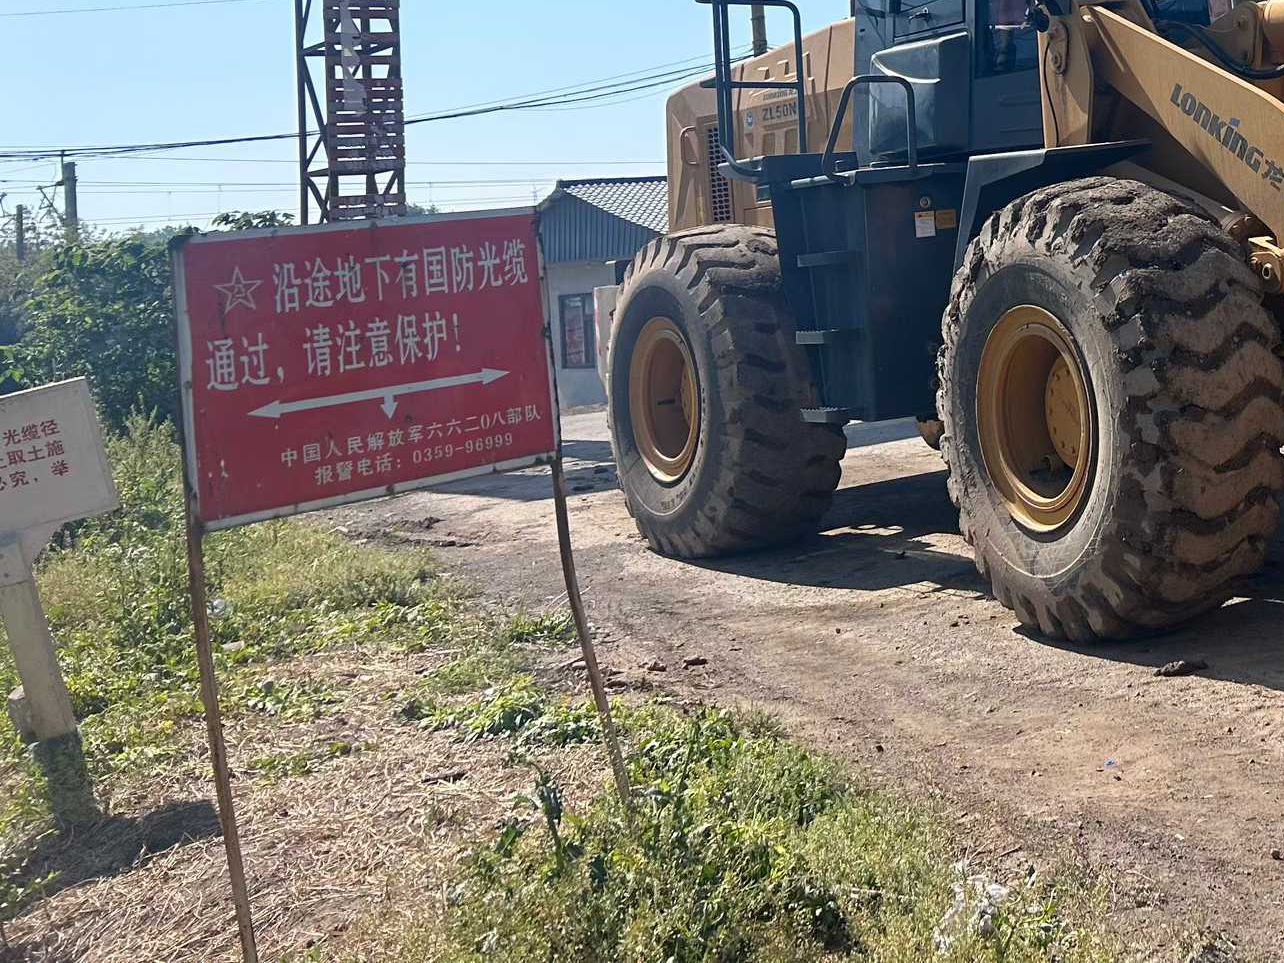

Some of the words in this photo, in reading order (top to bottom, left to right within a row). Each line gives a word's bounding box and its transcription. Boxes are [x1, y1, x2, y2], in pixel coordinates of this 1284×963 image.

[762, 101, 798, 121] ZL50N
[272, 238, 529, 314] 沿途地下有国防光缆
[3, 419, 60, 446] 光缆径
